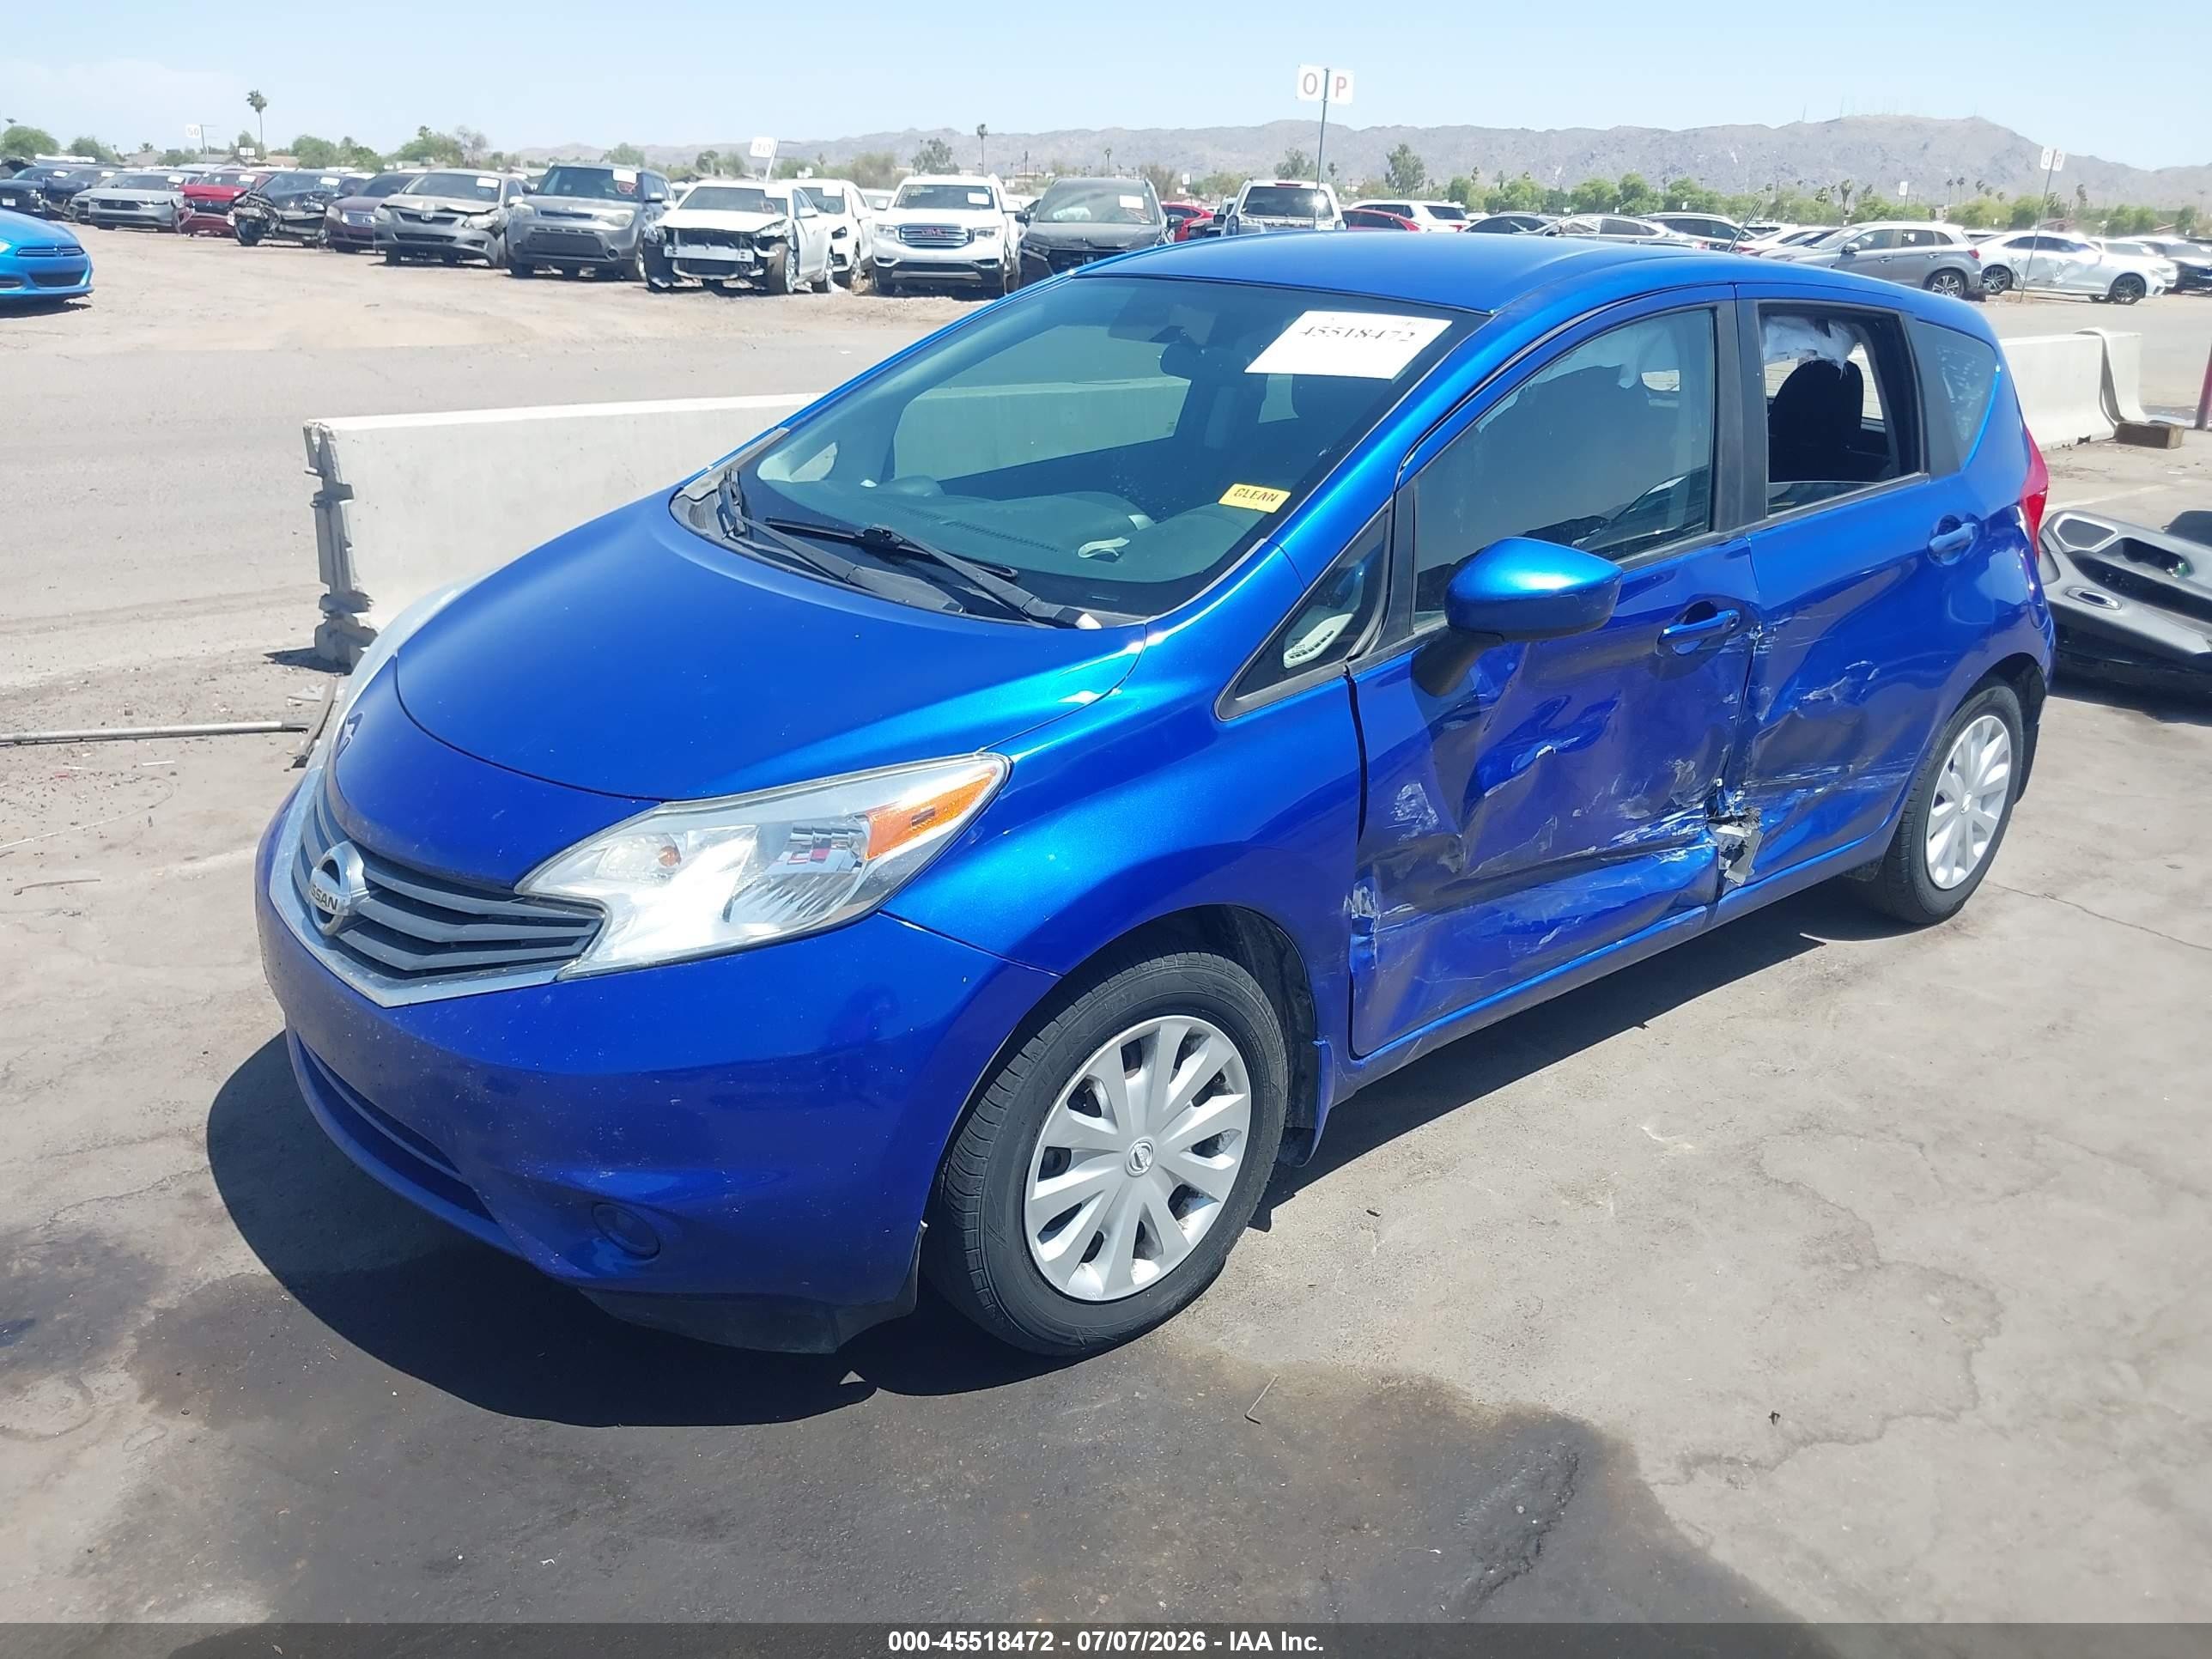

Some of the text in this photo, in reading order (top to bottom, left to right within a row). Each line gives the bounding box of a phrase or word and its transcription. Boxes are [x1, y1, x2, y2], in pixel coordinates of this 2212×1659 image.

[1303, 72, 1318, 95] O
[1335, 76, 1347, 98] P
[1298, 325, 1417, 342] 45518472
[1233, 488, 1279, 502] CLEAN
